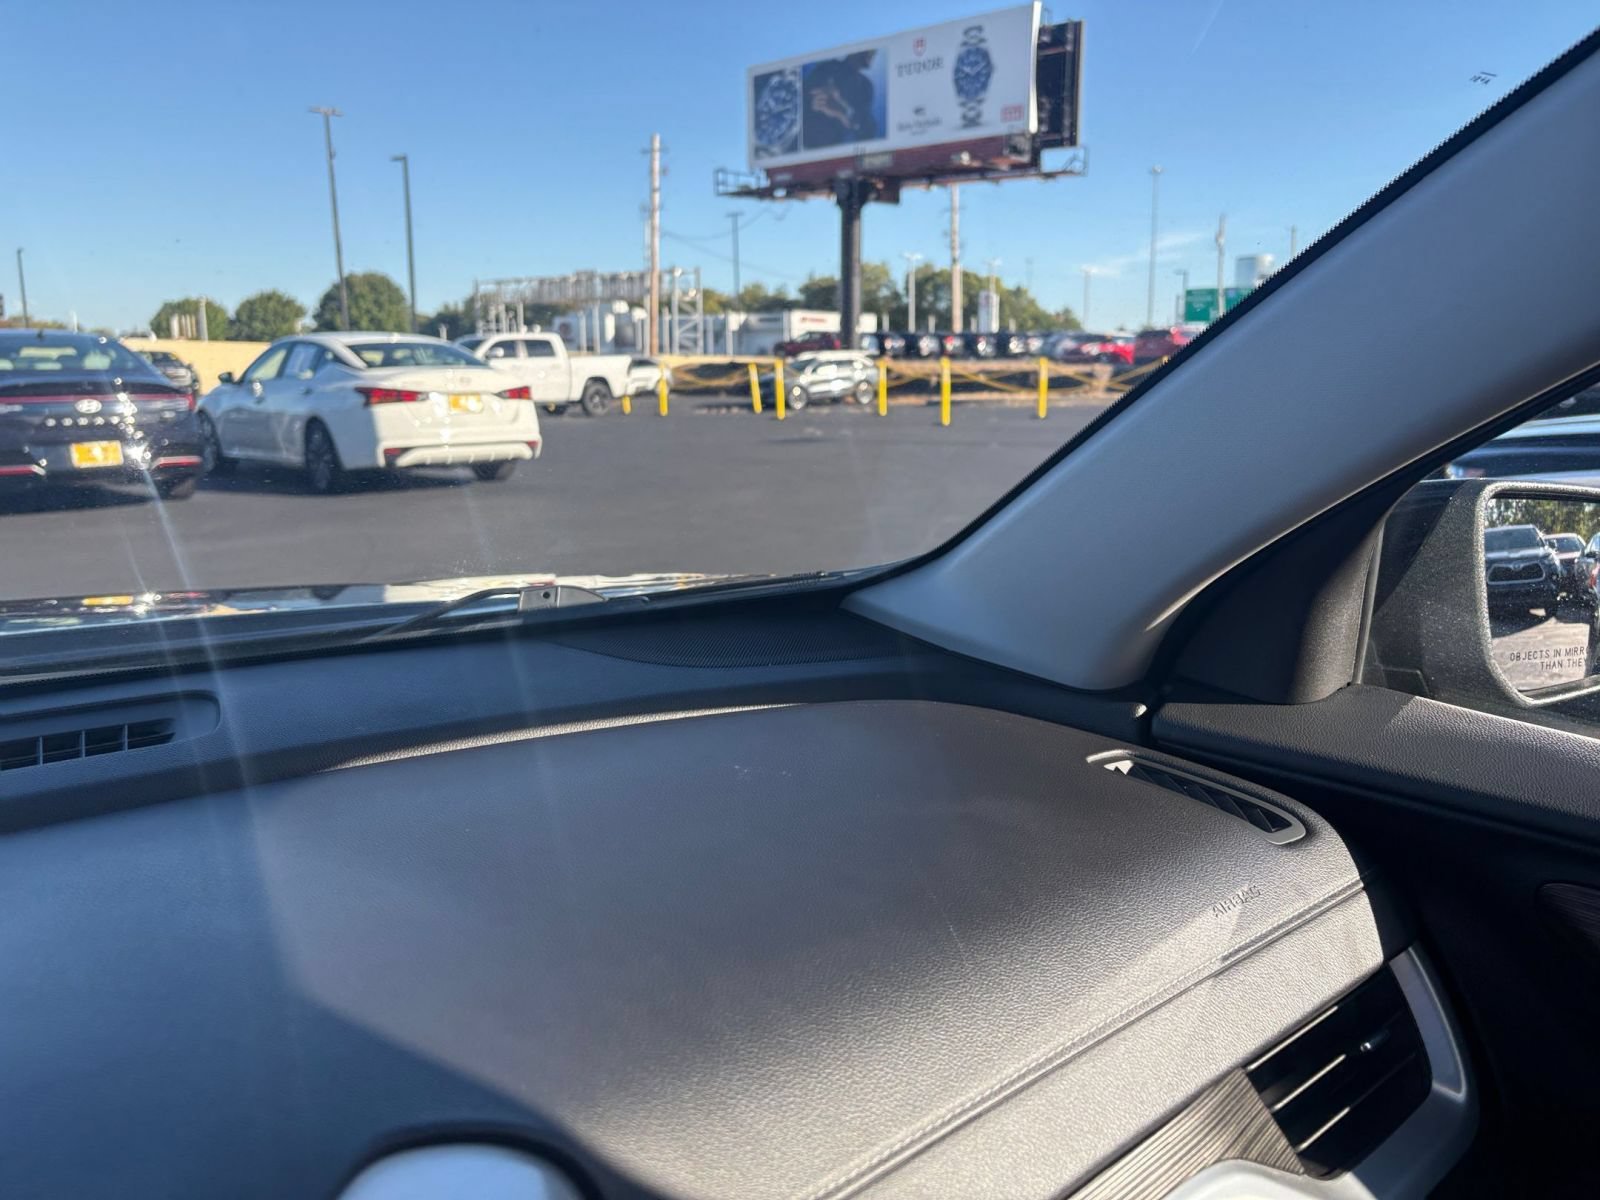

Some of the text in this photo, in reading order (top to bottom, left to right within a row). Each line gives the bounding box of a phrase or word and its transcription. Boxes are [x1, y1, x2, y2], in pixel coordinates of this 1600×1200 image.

[1509, 649, 1550, 662] OBJECTS
[1553, 648, 1562, 658] IN
[1540, 661, 1563, 671] THAN
[1212, 884, 1261, 918] AIRBAG
